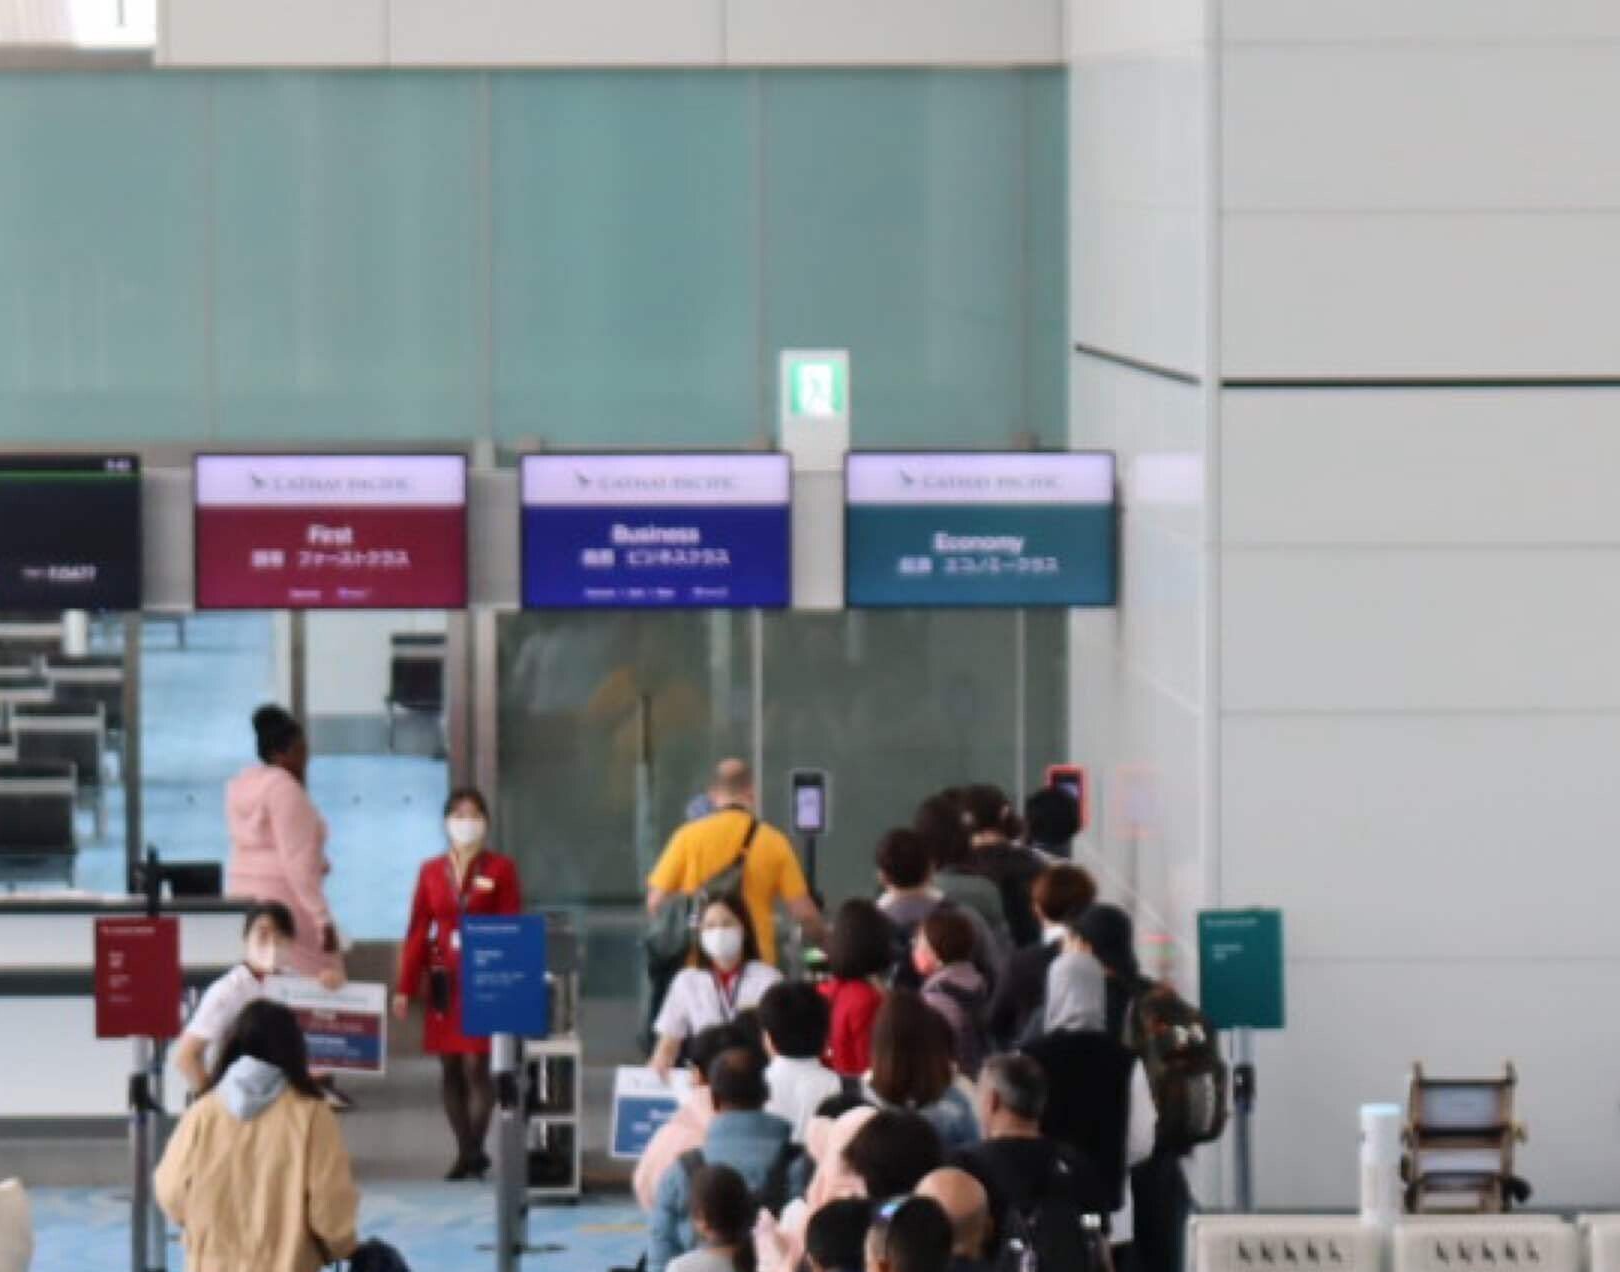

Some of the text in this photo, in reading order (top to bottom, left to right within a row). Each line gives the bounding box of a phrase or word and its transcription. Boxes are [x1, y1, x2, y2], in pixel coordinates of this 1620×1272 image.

[307, 524, 354, 545] First
[611, 523, 701, 545] Business
[933, 530, 1025, 554] Economy
